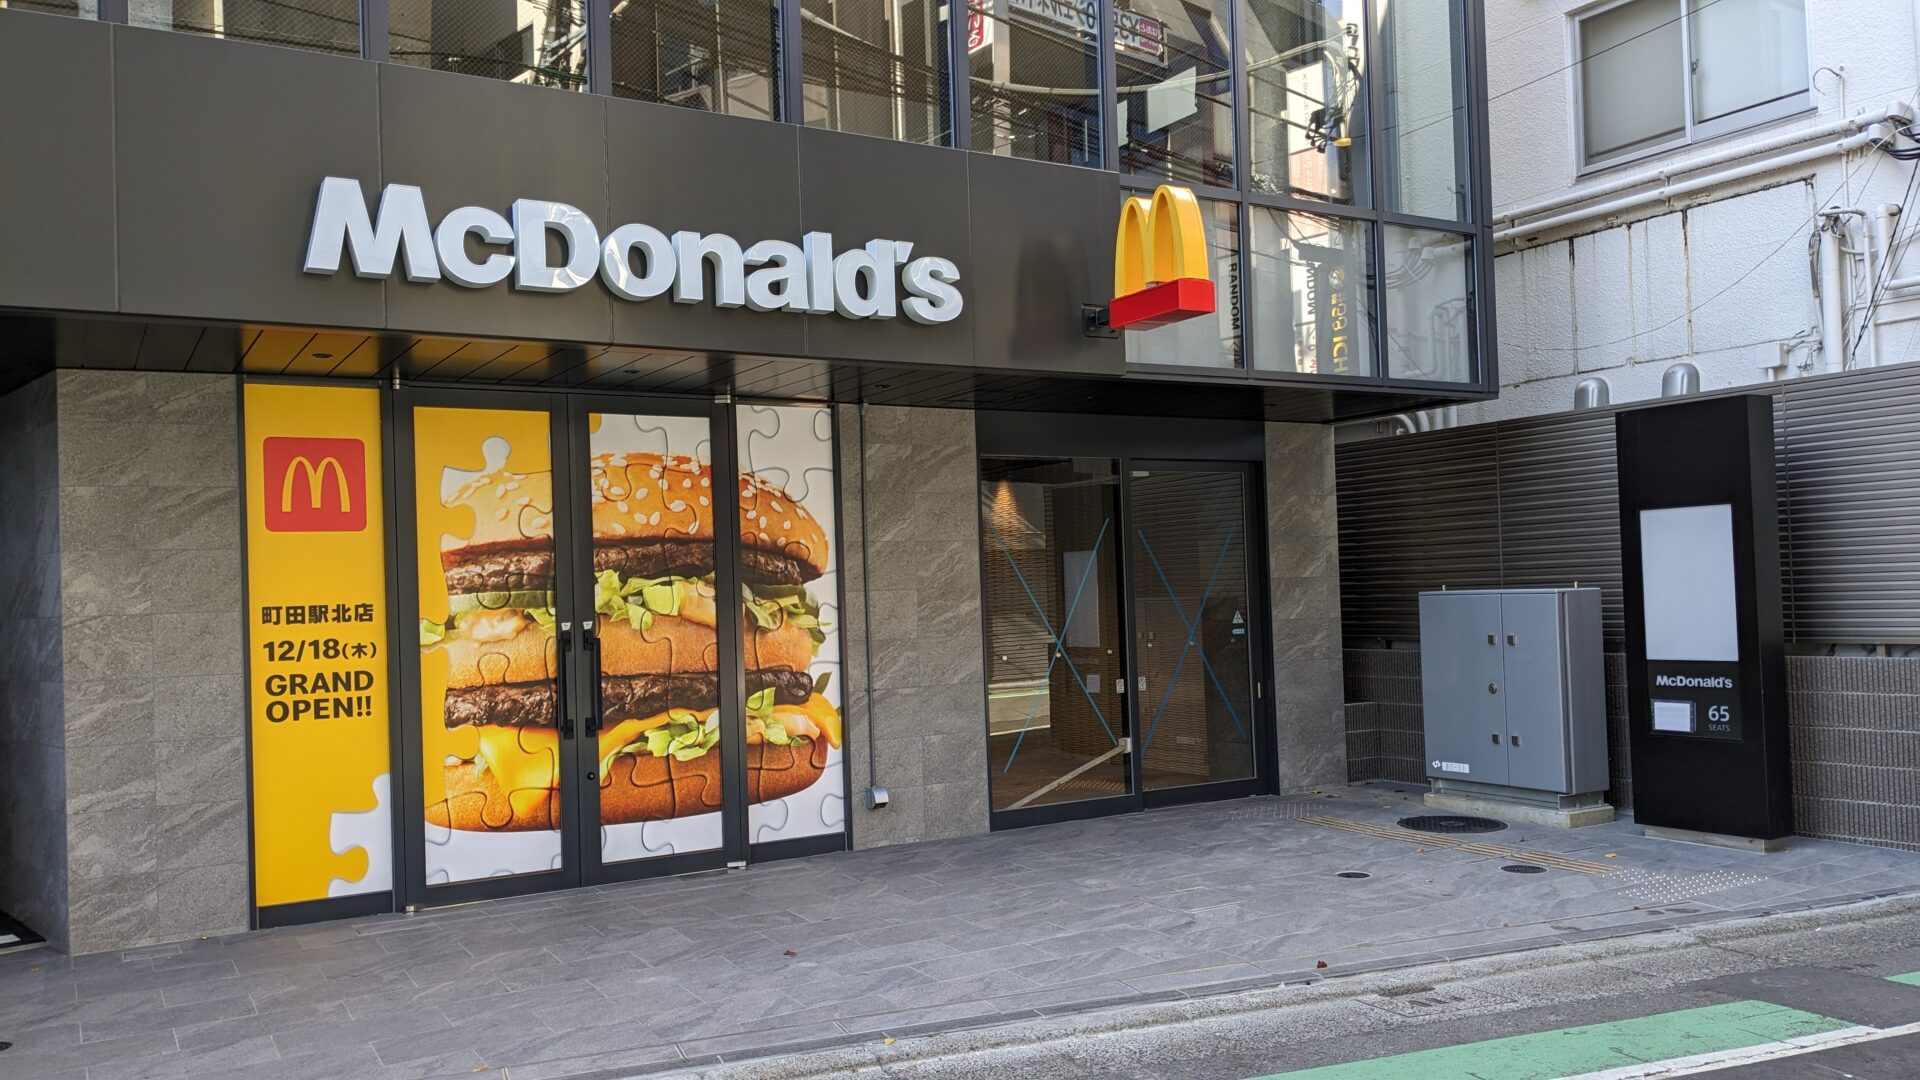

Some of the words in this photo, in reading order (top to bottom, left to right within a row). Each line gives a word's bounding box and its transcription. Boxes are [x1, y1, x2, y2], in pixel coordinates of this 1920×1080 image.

[304, 176, 964, 325] McDonald's
[1229, 262, 1241, 331] RANDOM
[261, 602, 374, 626] 町田駅北店
[265, 670, 374, 697] GRAND
[1656, 675, 1733, 689] McDonald's
[265, 695, 372, 723] OPEN!!
[1708, 705, 1730, 722] 65
[1708, 723, 1731, 732] SEATS
